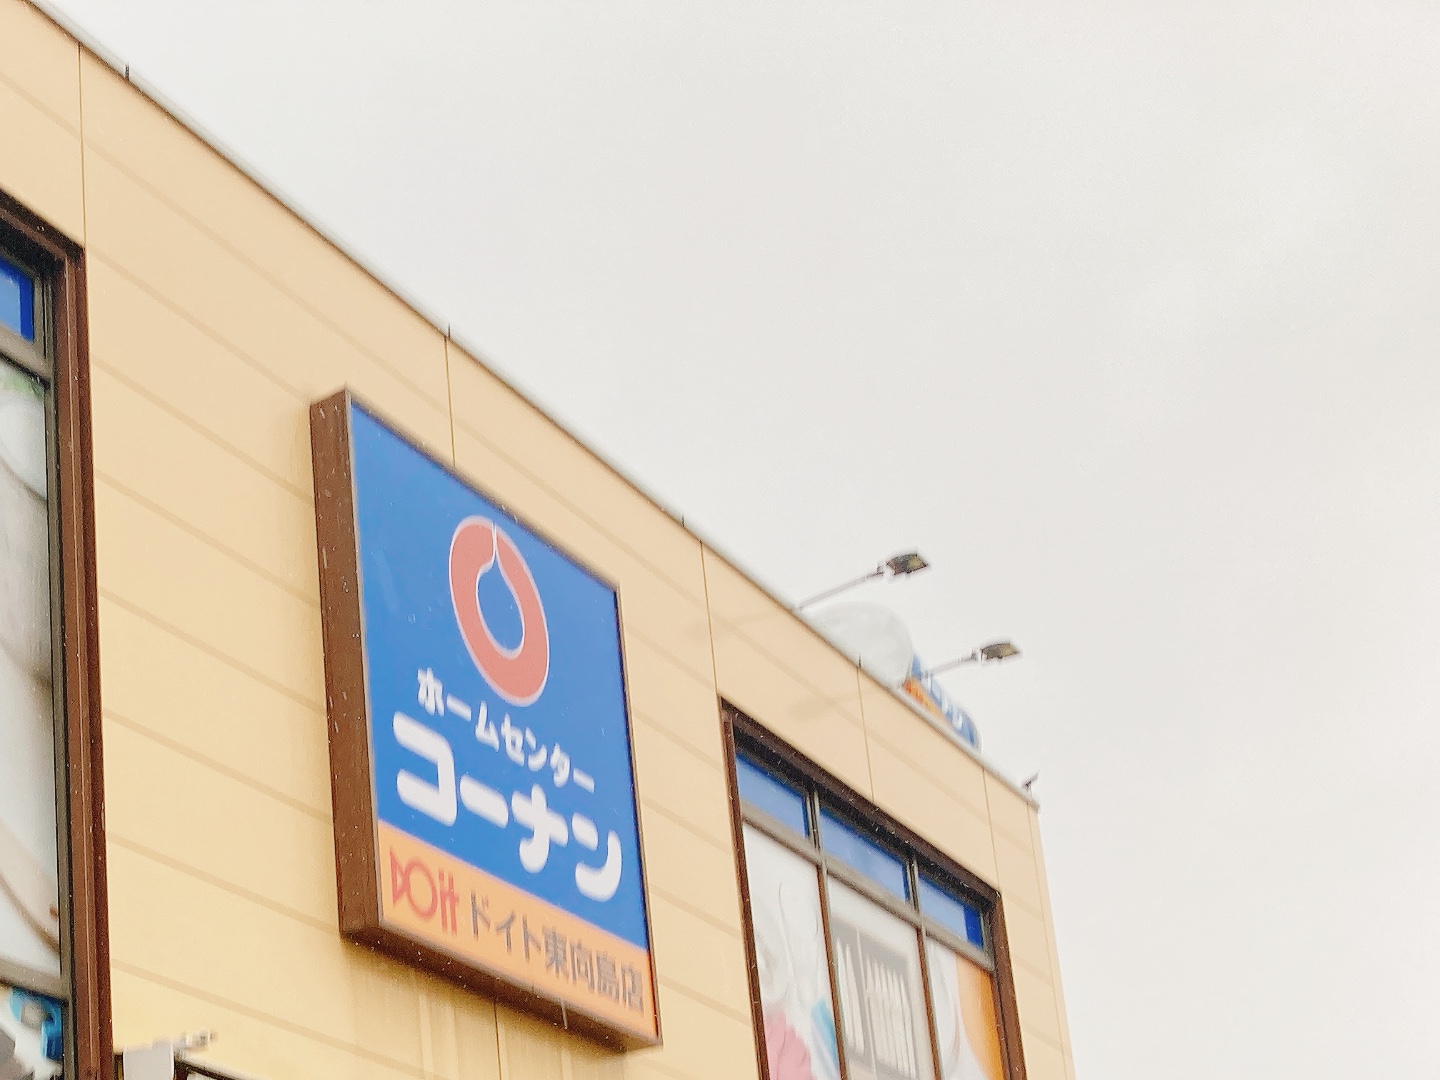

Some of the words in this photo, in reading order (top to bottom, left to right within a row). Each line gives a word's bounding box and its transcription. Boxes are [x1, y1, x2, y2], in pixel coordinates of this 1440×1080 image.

[393, 711, 622, 901] コーナン
[417, 667, 595, 793] ホームセンター
